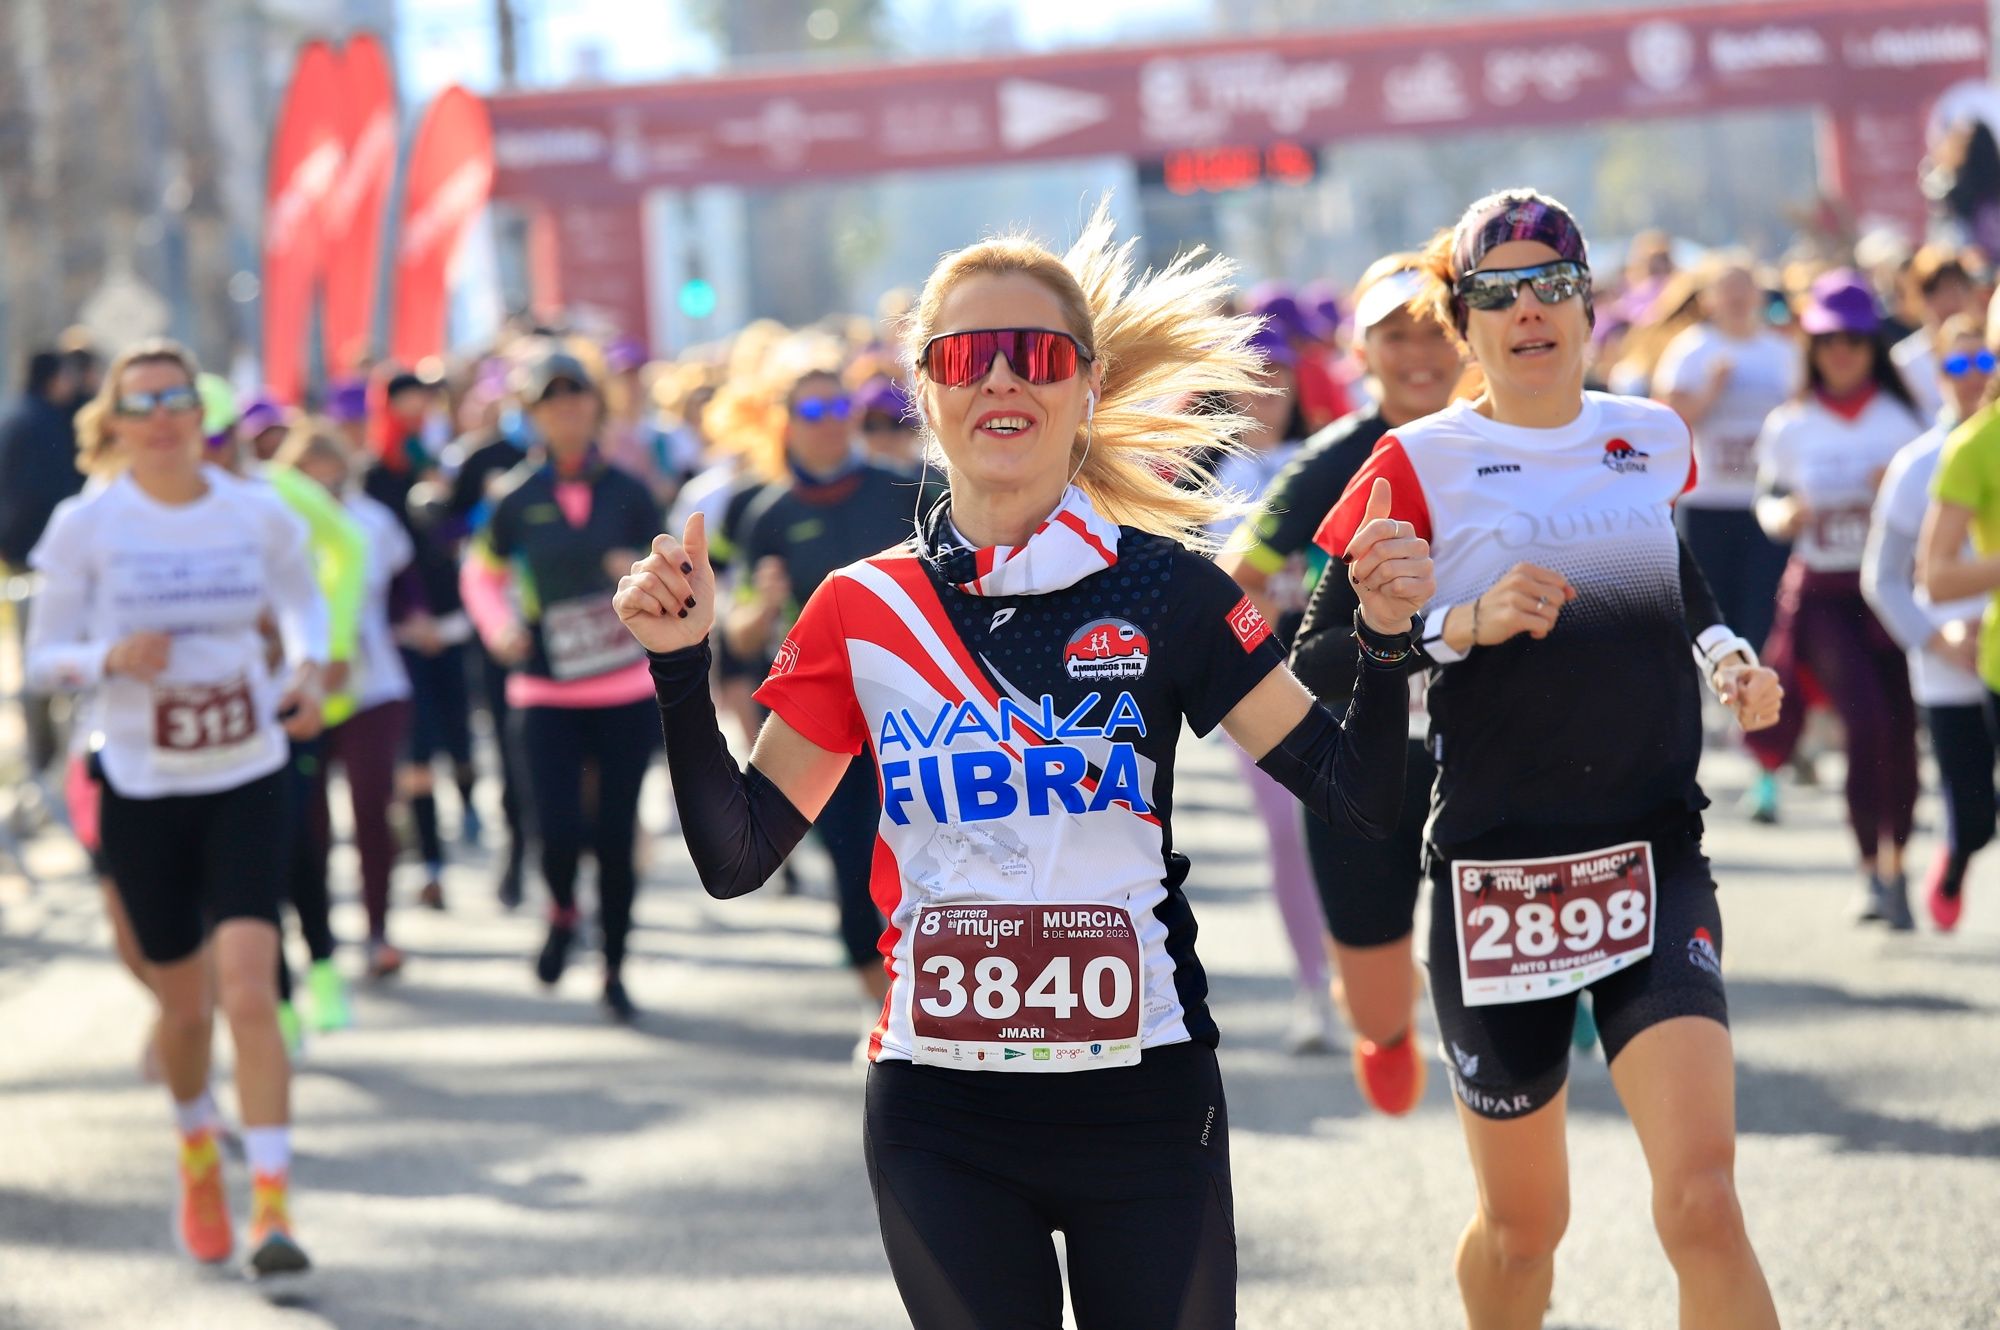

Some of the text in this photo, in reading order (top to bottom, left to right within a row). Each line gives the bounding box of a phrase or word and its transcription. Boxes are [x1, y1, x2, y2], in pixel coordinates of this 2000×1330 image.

[1477, 463, 1521, 477] FASTER
[1121, 662, 1142, 671] TRAIL
[879, 691, 1148, 756] AVANZA
[881, 743, 1150, 826] FIBRA
[946, 909, 988, 919] carrera
[1043, 911, 1127, 928] MURCIA
[956, 919, 1024, 949] mujer
[1067, 930, 1104, 938] MARZO
[1106, 929, 1130, 938] 2023
[1467, 890, 1646, 960] 2898
[1511, 961, 1548, 974] ANTO
[1549, 951, 1608, 971] ESPECIAL
[919, 955, 1133, 1020] 3840
[998, 1027, 1045, 1039] JMARI
